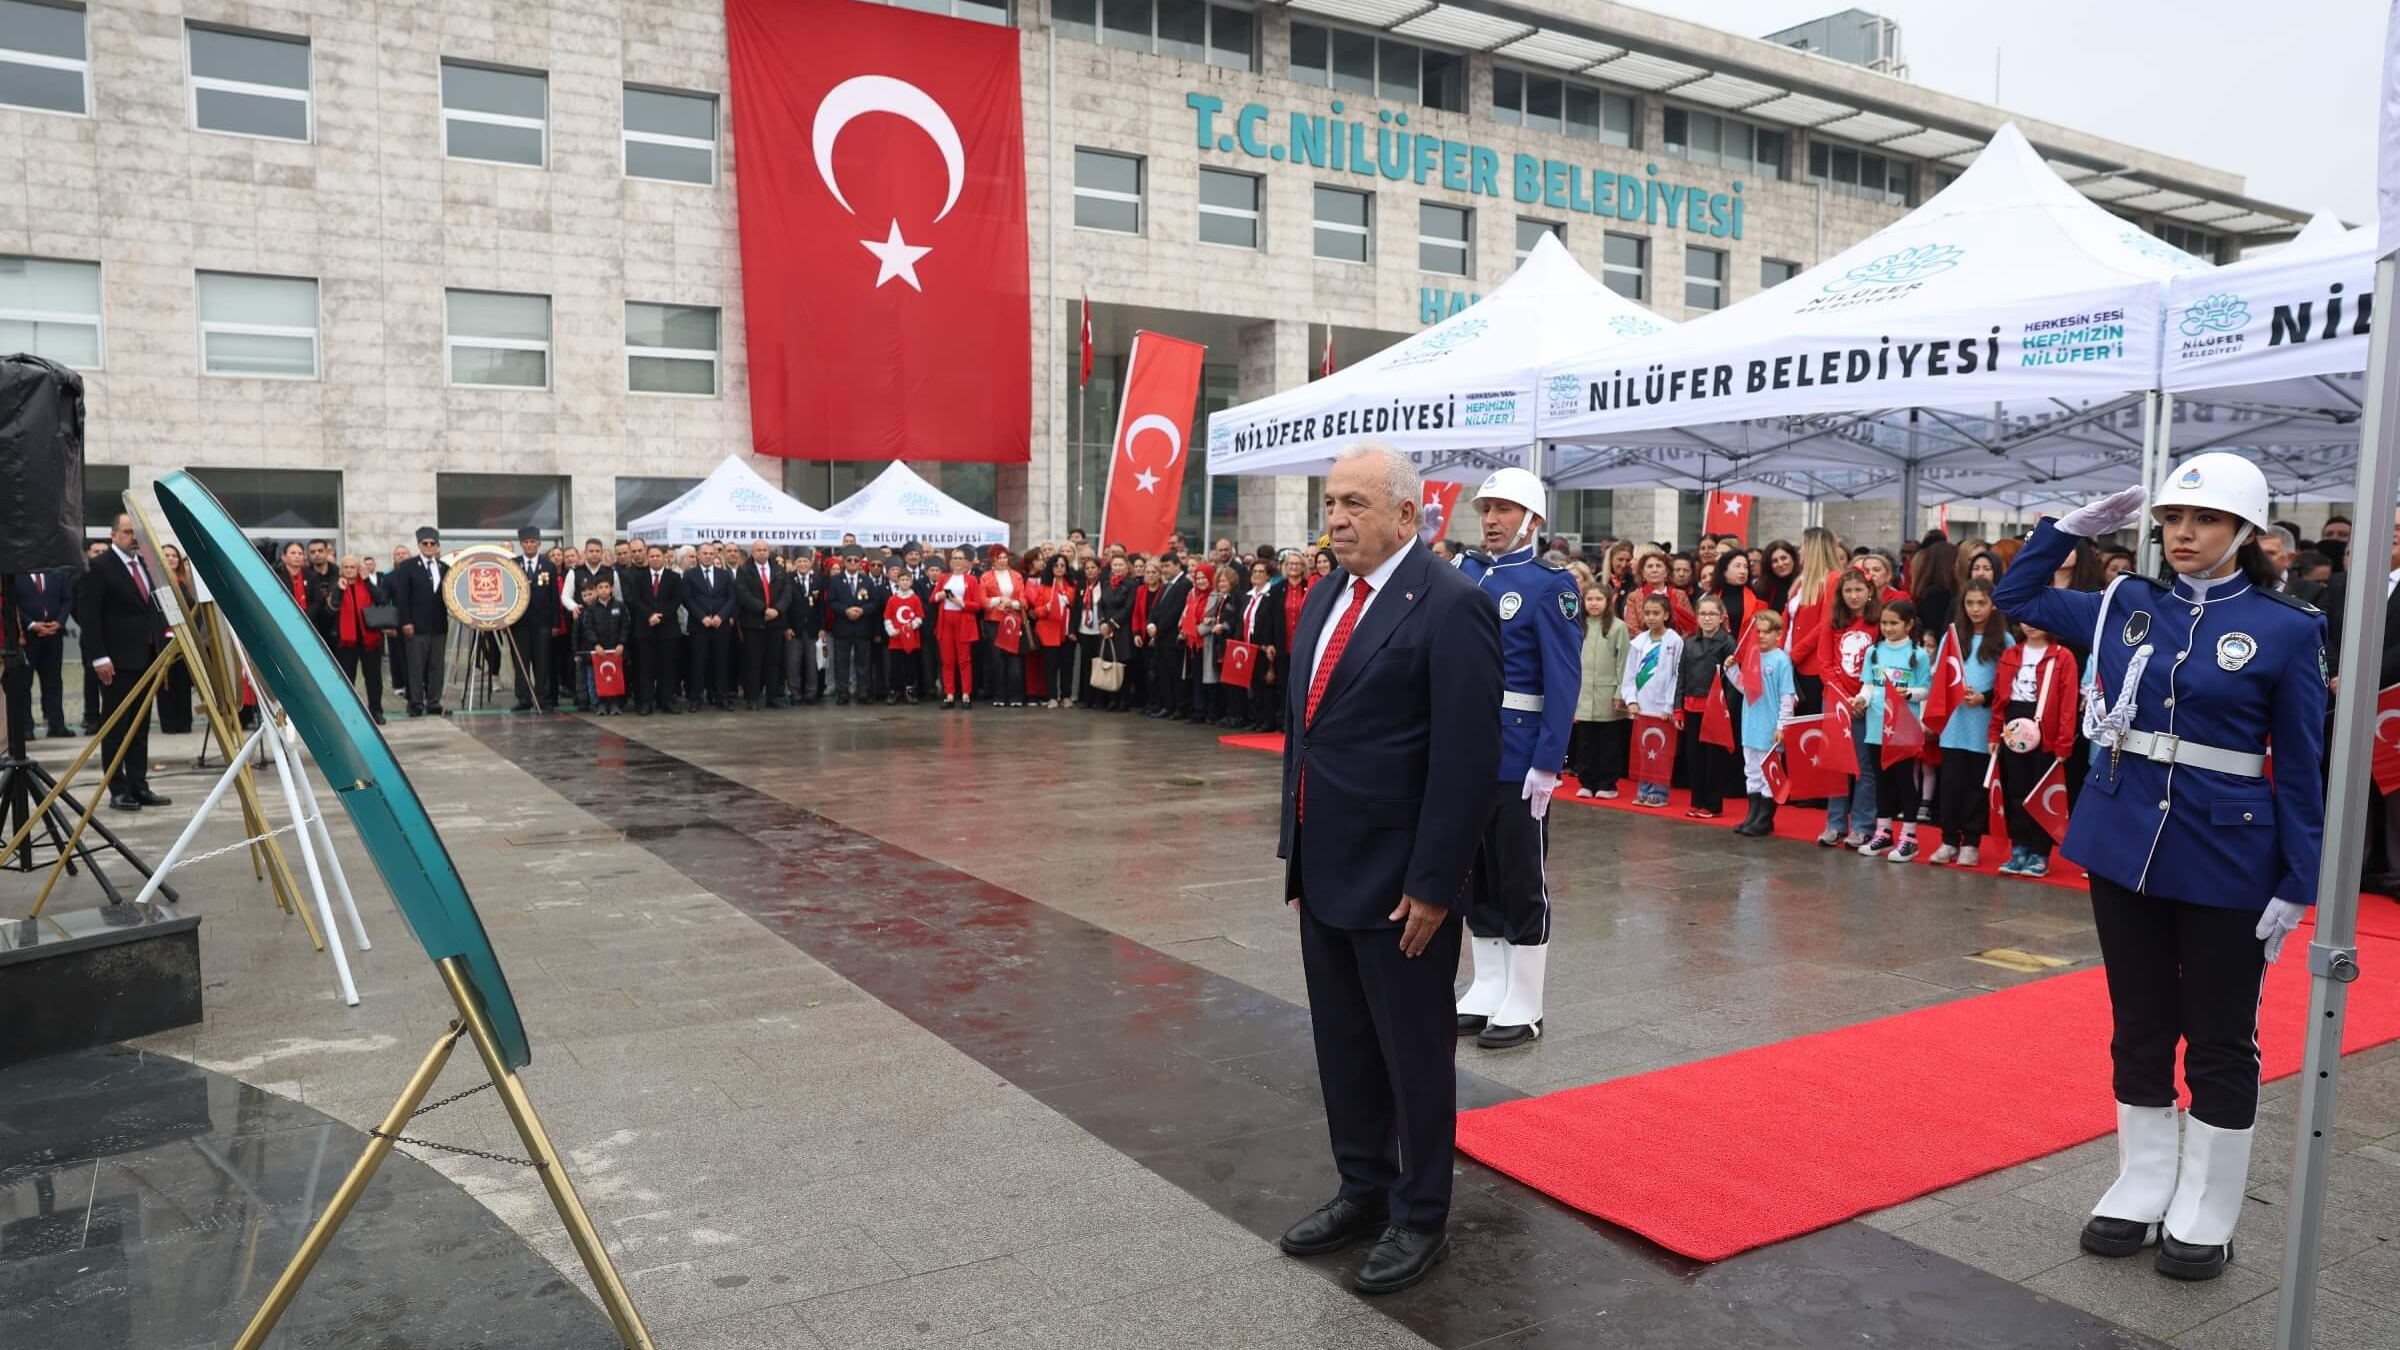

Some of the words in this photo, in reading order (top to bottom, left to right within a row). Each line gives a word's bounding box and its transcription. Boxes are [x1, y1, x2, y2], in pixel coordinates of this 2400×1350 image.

[1513, 153, 1743, 240] BELEDİYESİ
[2024, 313, 2091, 333] HERKESİN
[2093, 307, 2125, 323] SESİ
[2022, 323, 2124, 350] HEPİMİZİN
[2182, 333, 2245, 350] NİLÜFER
[1589, 364, 1733, 412] NİLÜFER
[1746, 325, 2001, 394] BELEDİYESİ
[1234, 418, 1317, 454] NİLÜFER
[1322, 393, 1455, 439] BELEDİYESİ
[697, 528, 747, 541] NİLÜFER
[750, 528, 817, 541] BELEDİYESİ
[921, 531, 982, 543] BELEDİYESİ
